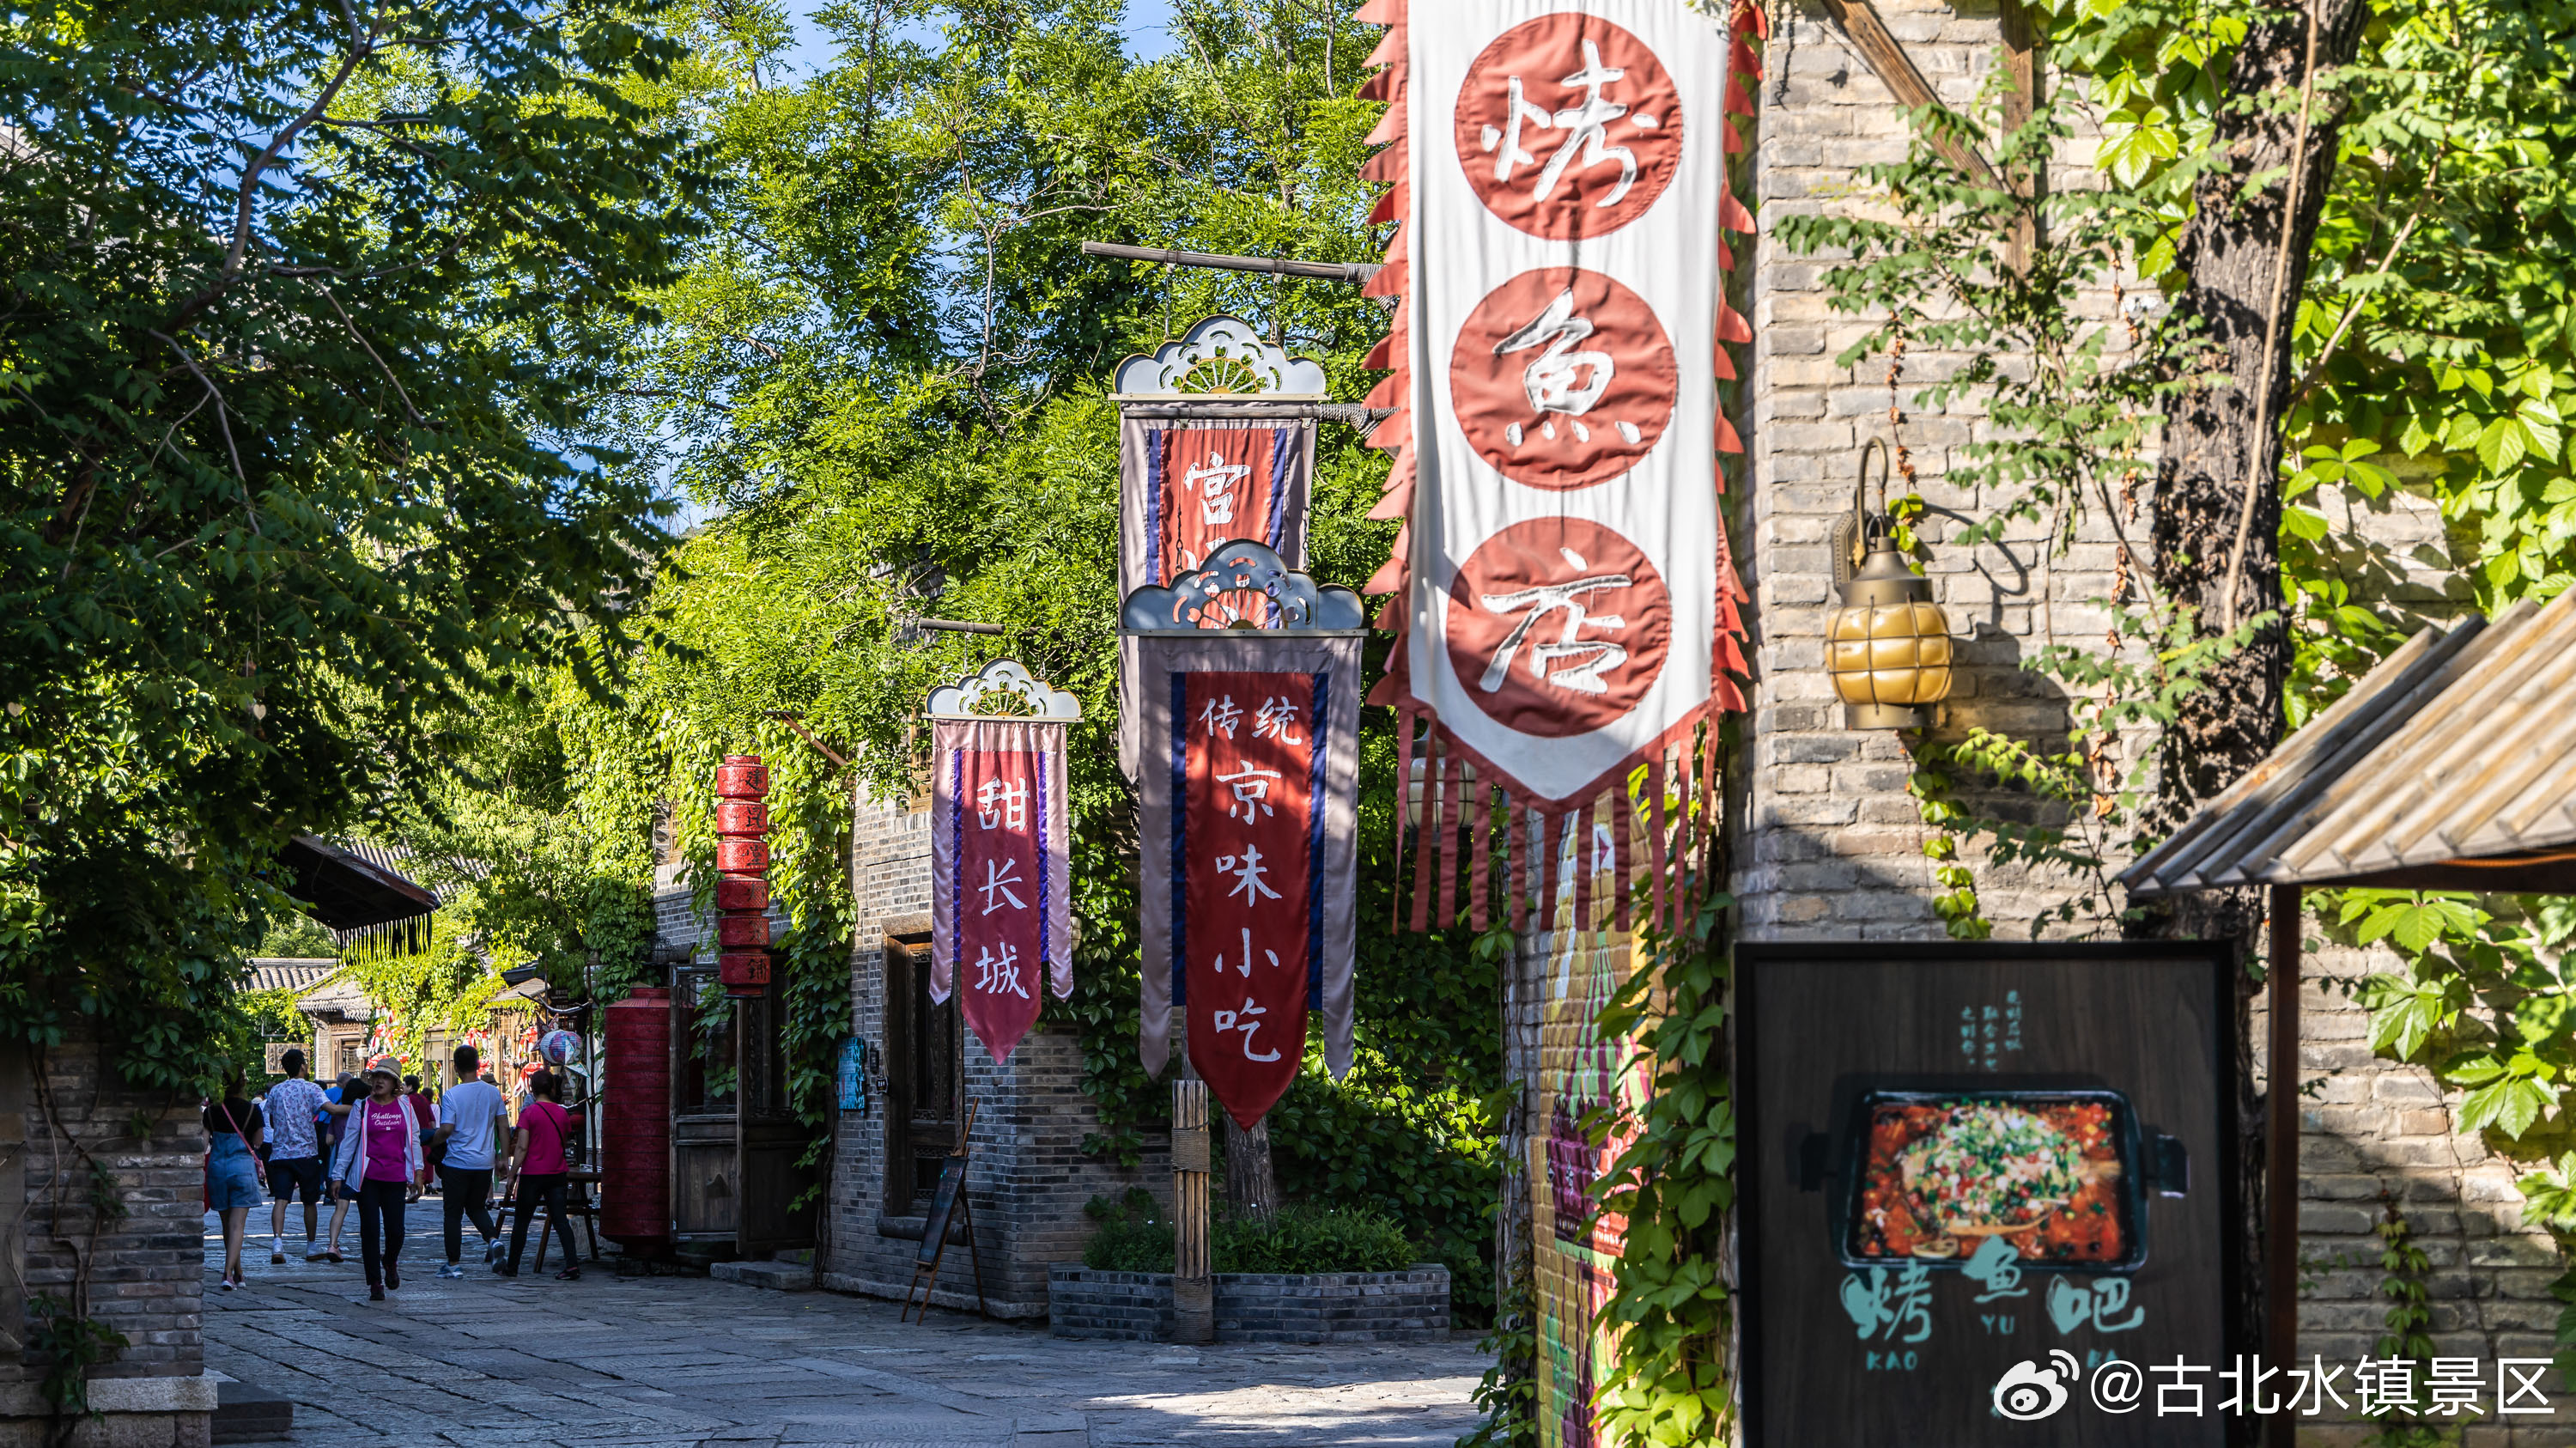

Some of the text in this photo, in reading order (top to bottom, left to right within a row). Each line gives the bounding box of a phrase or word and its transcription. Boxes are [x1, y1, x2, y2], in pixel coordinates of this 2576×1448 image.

[1198, 694, 1303, 745] 传统
[975, 777, 1030, 1000] 甜长城
[1213, 759, 1283, 1062] 京味小吃
[1840, 1234, 2146, 1343] 烤鱼吧
[1866, 1314, 2121, 1372] KAO YU BA
